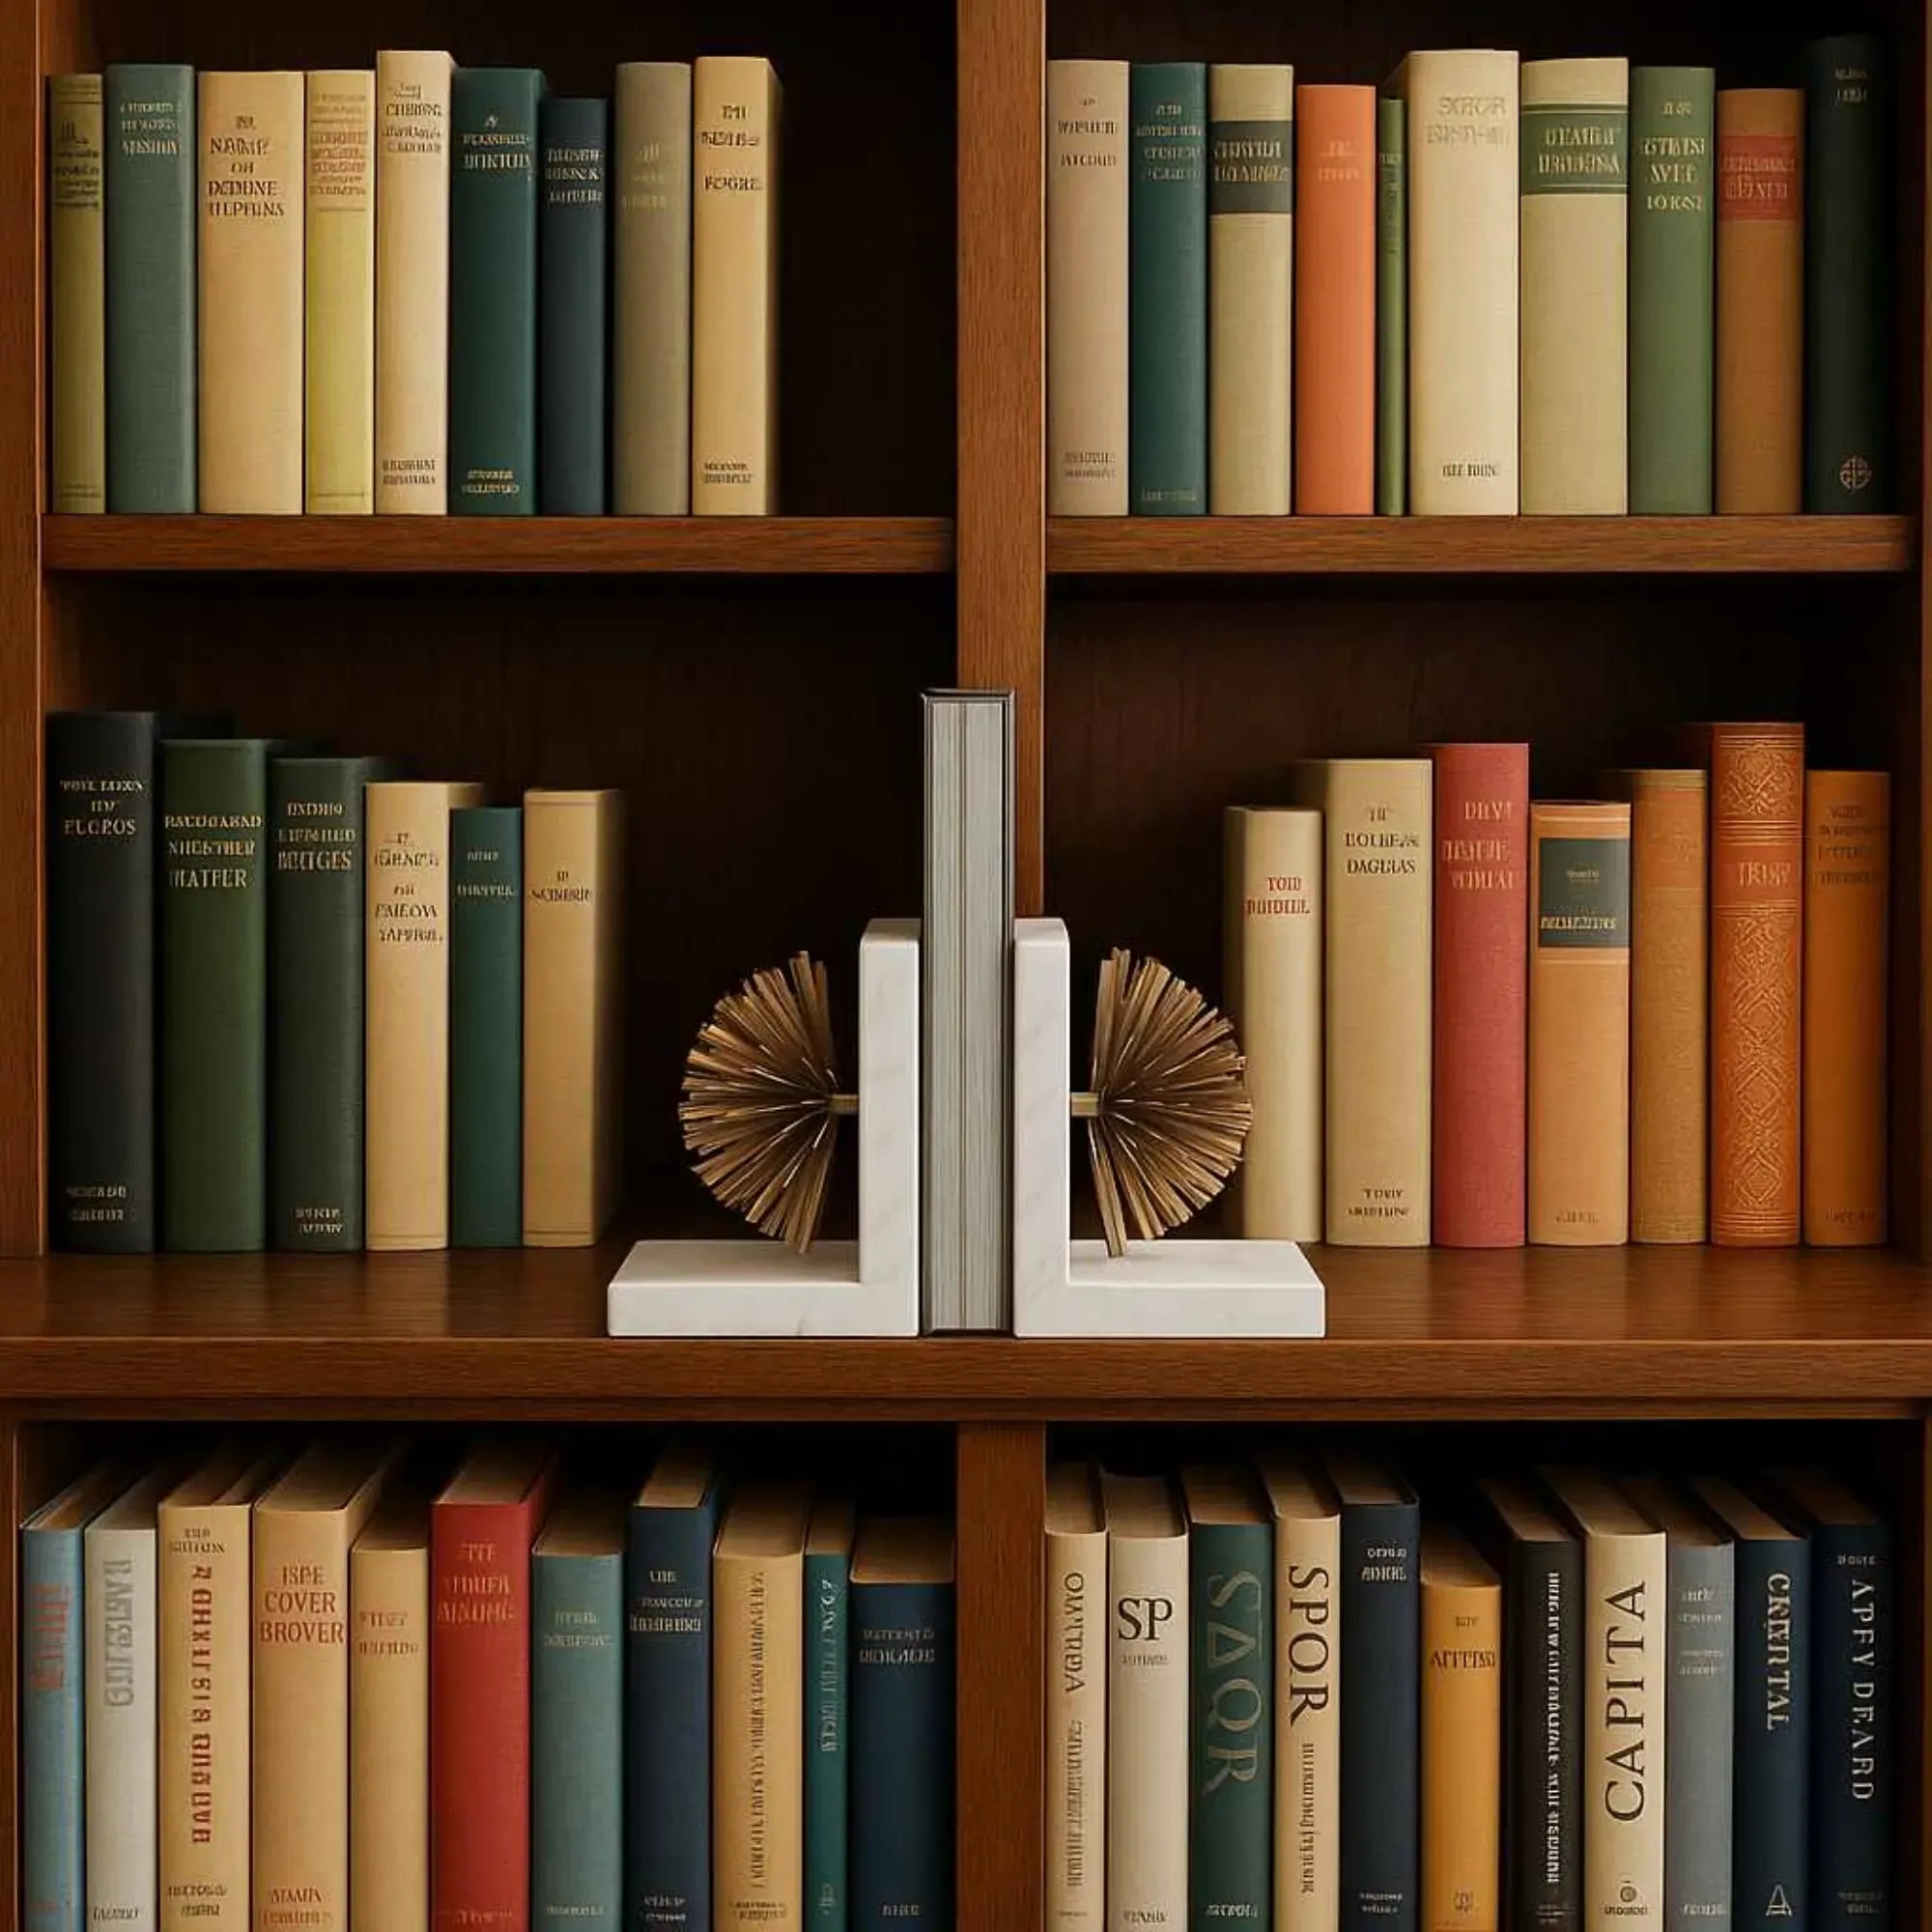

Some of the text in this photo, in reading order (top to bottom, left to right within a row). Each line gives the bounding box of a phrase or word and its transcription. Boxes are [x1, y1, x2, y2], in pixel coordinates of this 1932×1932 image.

[266, 1591, 335, 1614] COVER
[1117, 1597, 1173, 1641] SP
[260, 1620, 345, 1644] BROVER
[1288, 1565, 1329, 1727] SPOR
[1604, 1580, 1646, 1822] CAPITA
